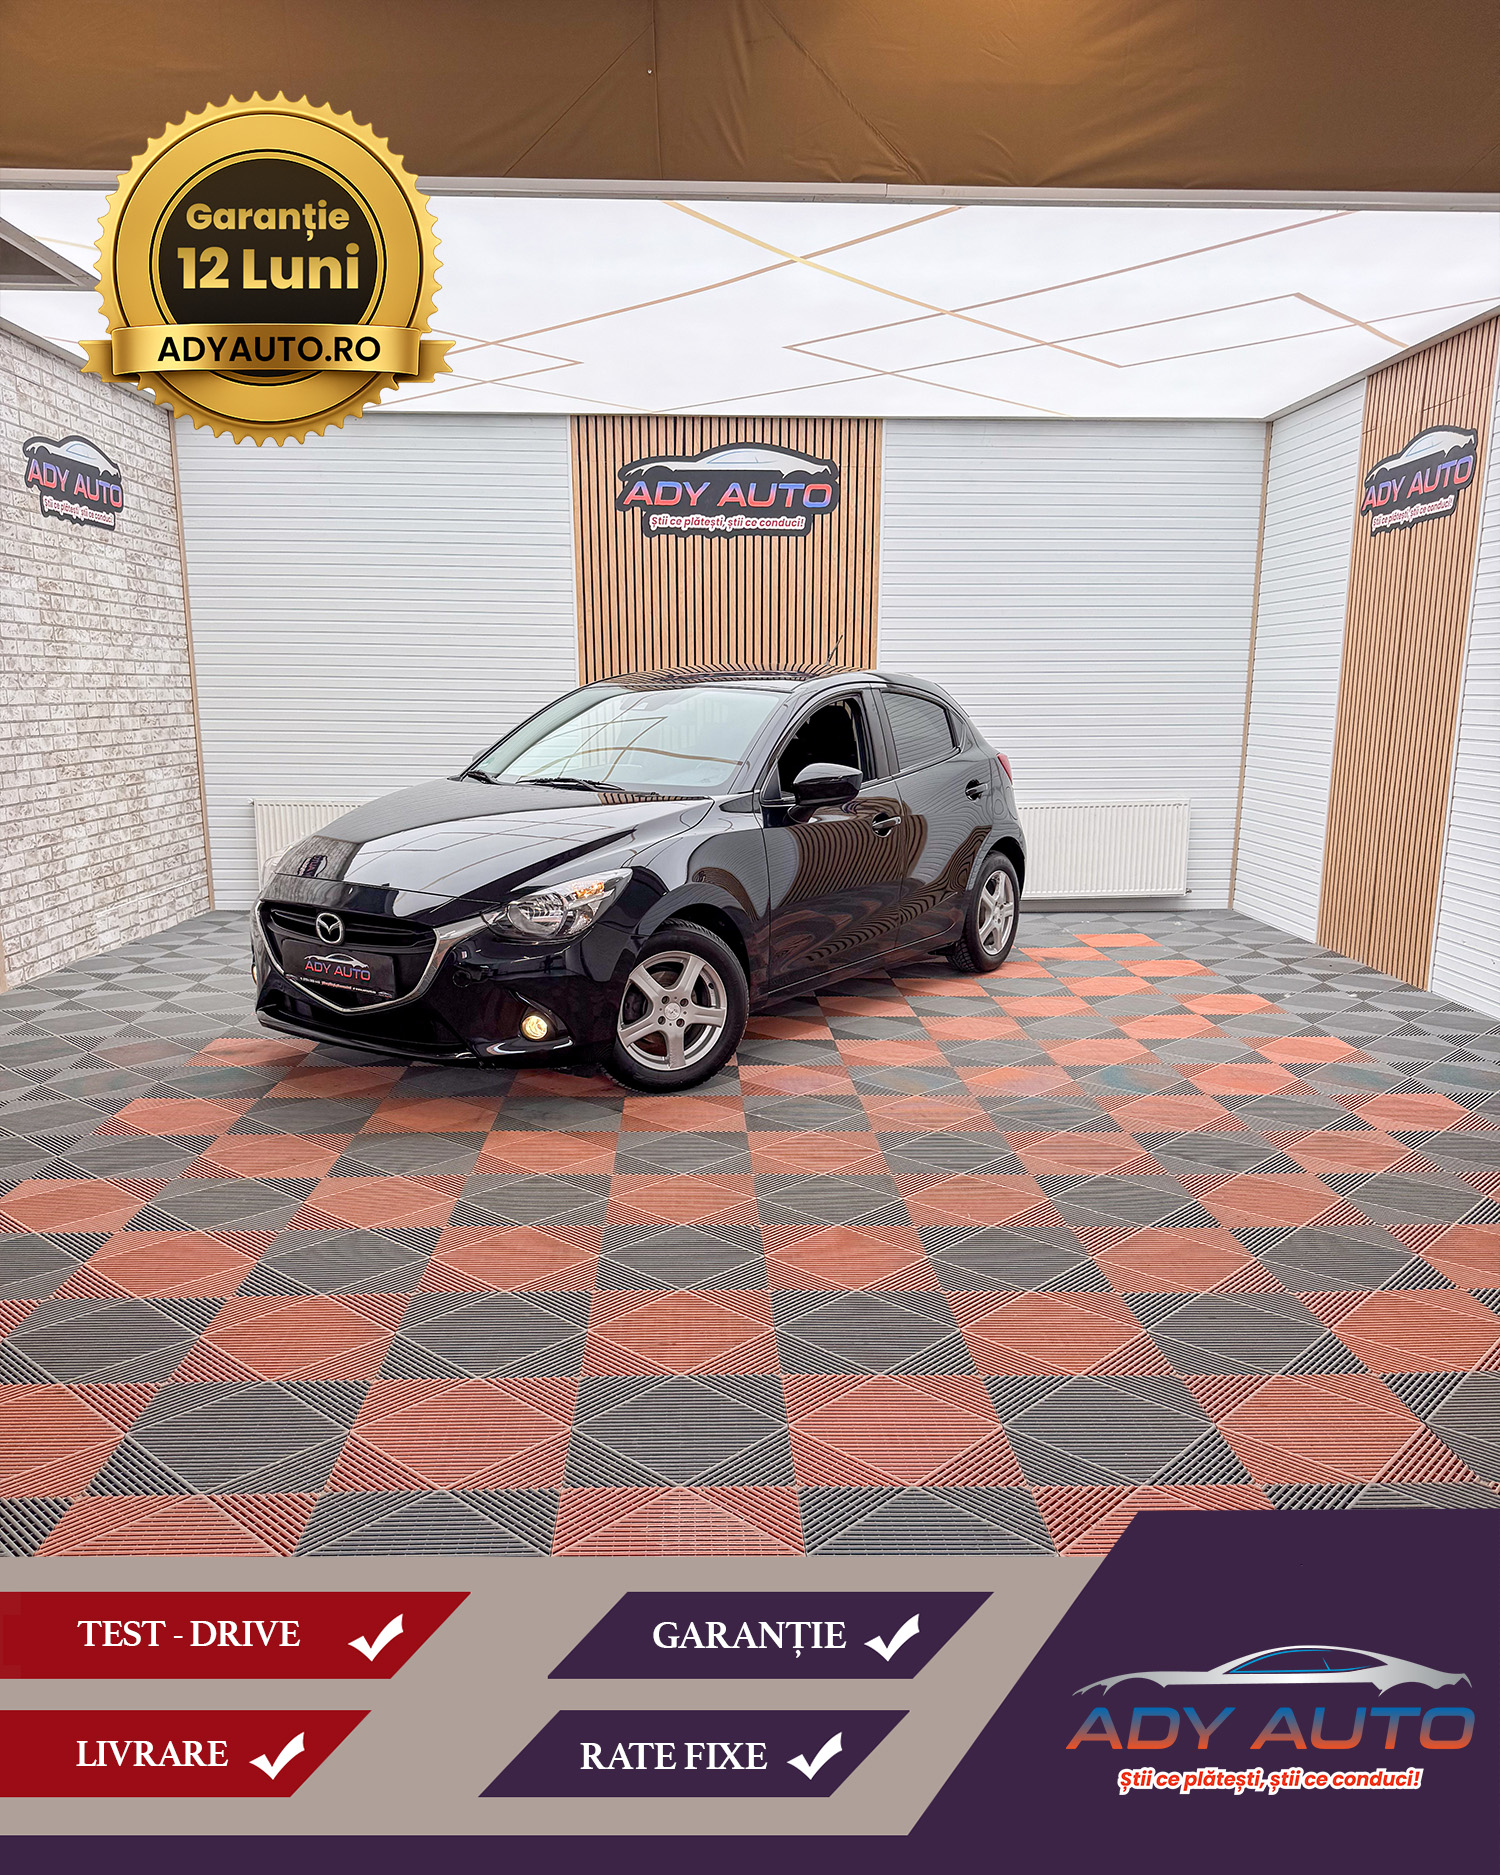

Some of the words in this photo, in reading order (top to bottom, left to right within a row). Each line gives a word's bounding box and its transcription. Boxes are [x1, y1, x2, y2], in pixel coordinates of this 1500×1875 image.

[27, 459, 69, 492] ADY
[73, 473, 122, 508] AUTO
[623, 480, 711, 506] ADY
[716, 482, 832, 508] AUTO
[1361, 475, 1406, 511] ADY
[1406, 454, 1473, 499] AUTO
[651, 515, 668, 528] Știi
[727, 517, 744, 529] știi
[745, 519, 758, 527] ce
[759, 518, 804, 527] conduci!
[304, 960, 331, 974] ADY
[333, 965, 371, 981] AUTO
